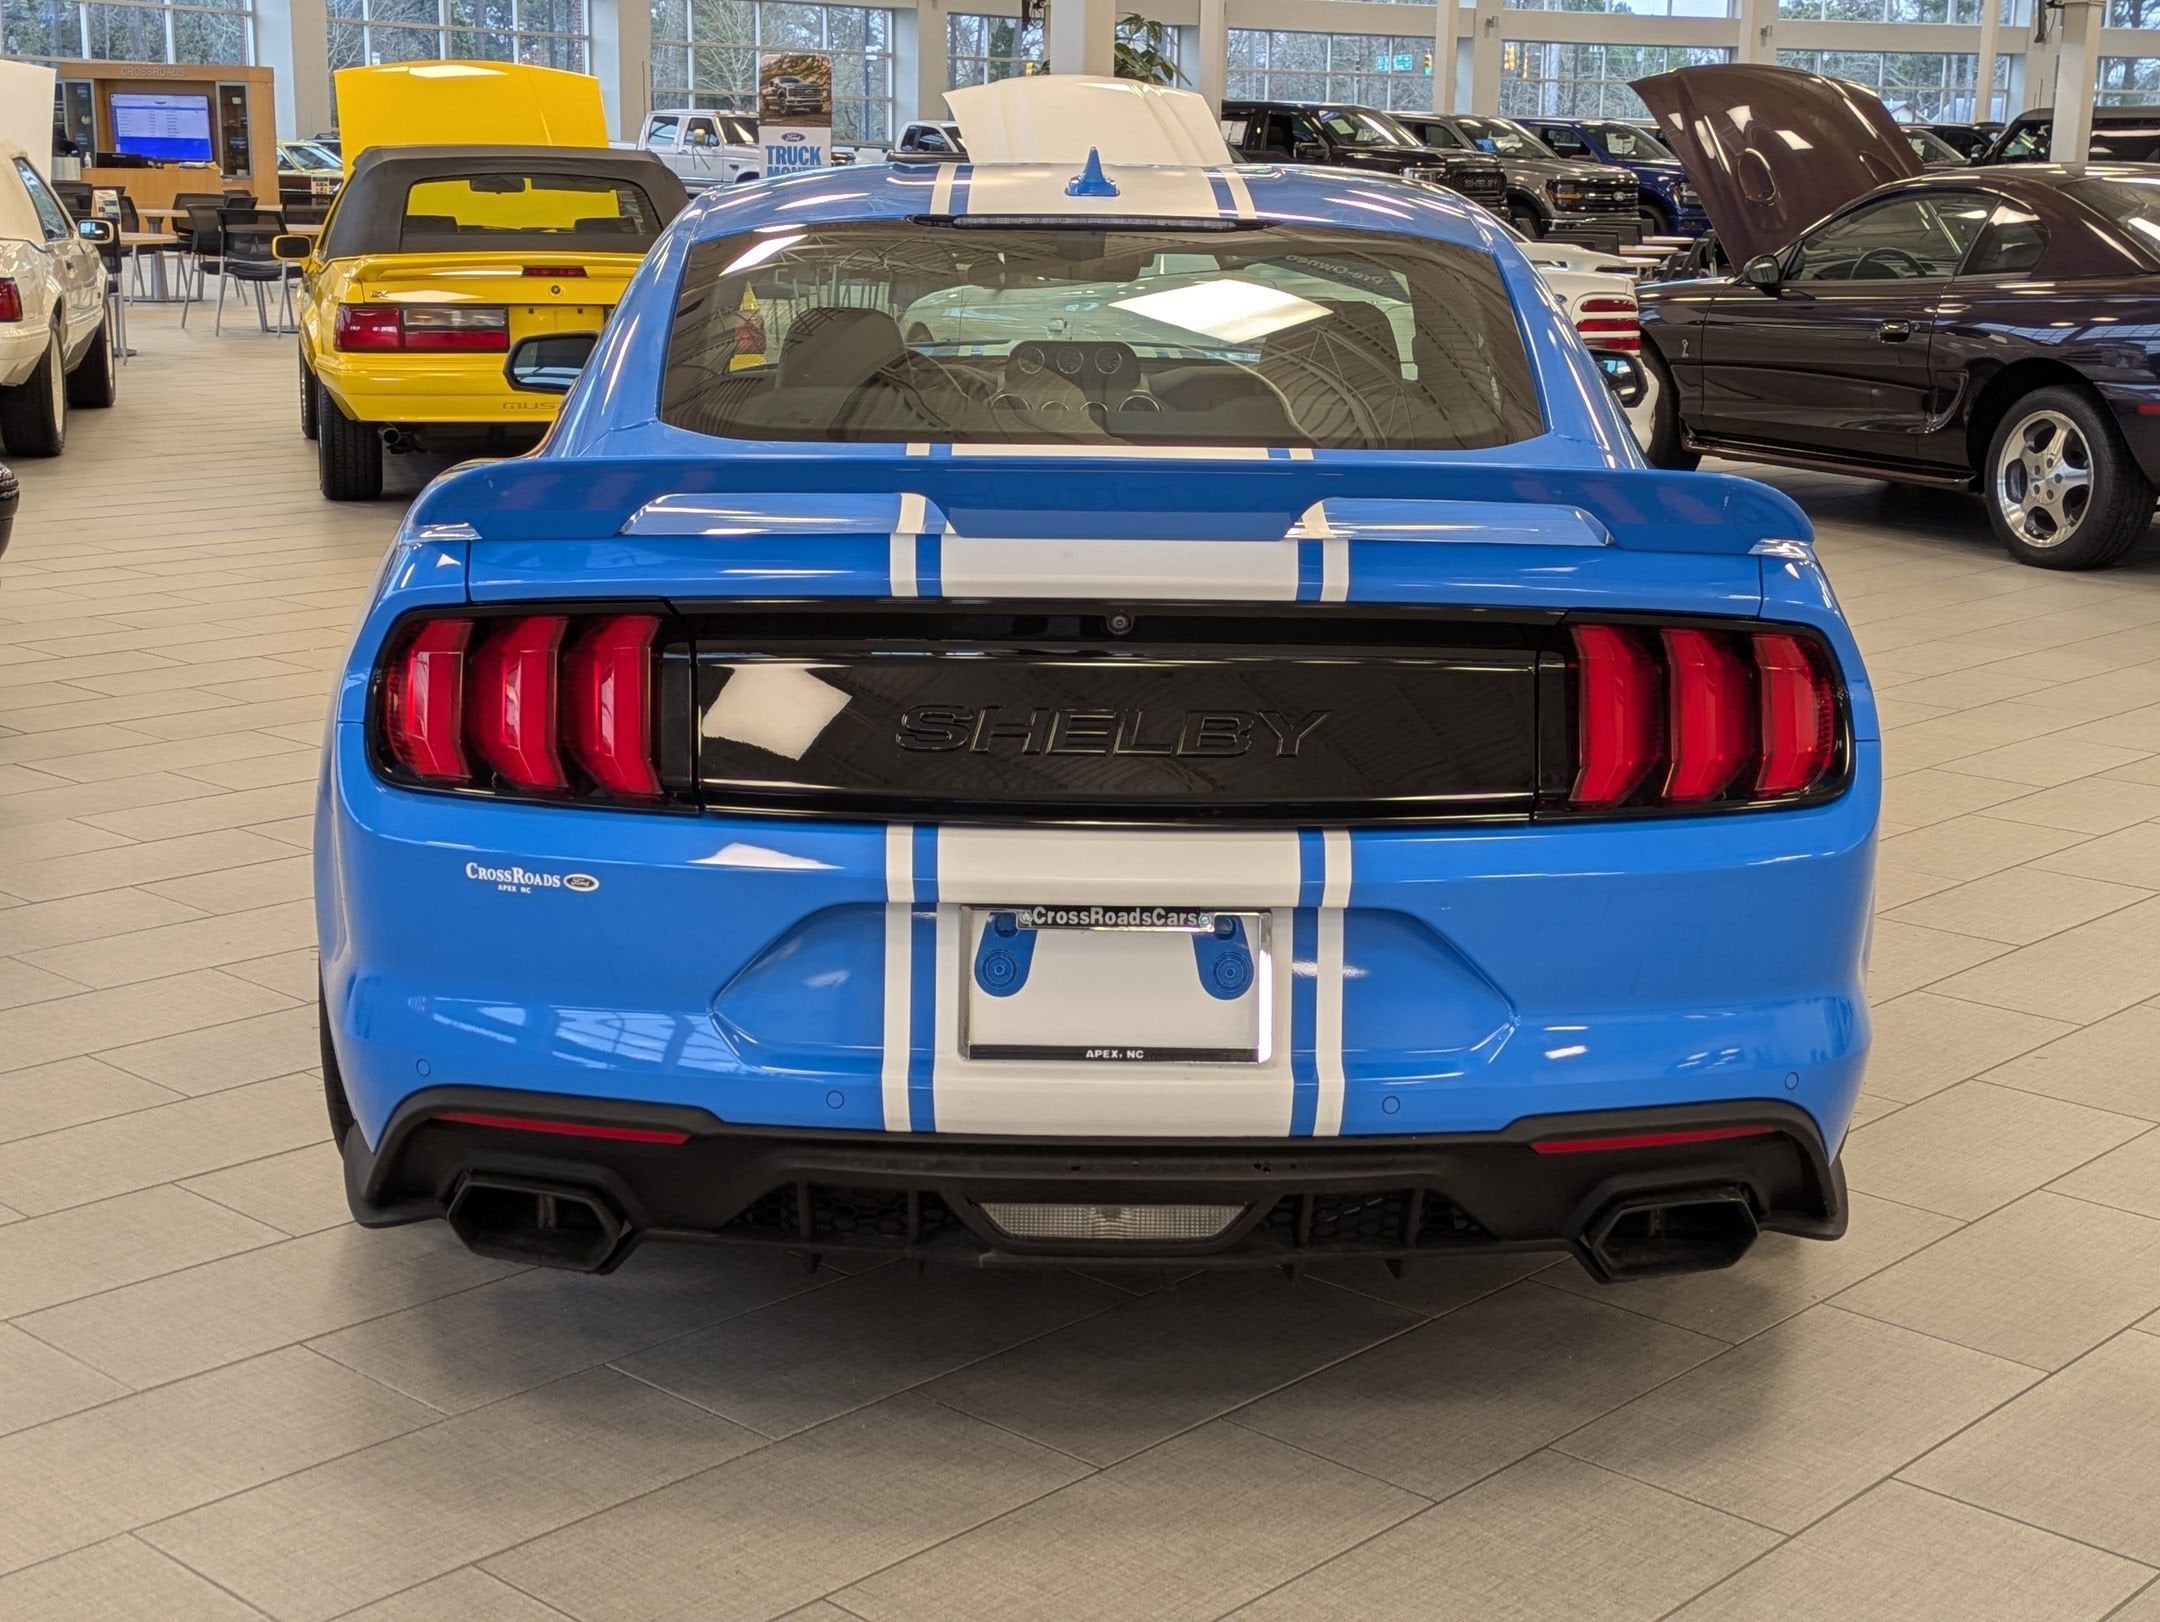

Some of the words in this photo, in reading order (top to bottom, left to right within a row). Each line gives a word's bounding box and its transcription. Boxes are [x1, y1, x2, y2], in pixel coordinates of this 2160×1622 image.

[121, 66, 185, 78] CROSSROADS
[765, 145, 822, 166] TRUCK
[896, 705, 1333, 757] SHELBY
[497, 884, 517, 892] APEX
[1032, 906, 1198, 926] CrossRoadsCars
[1126, 1050, 1144, 1059] NC
